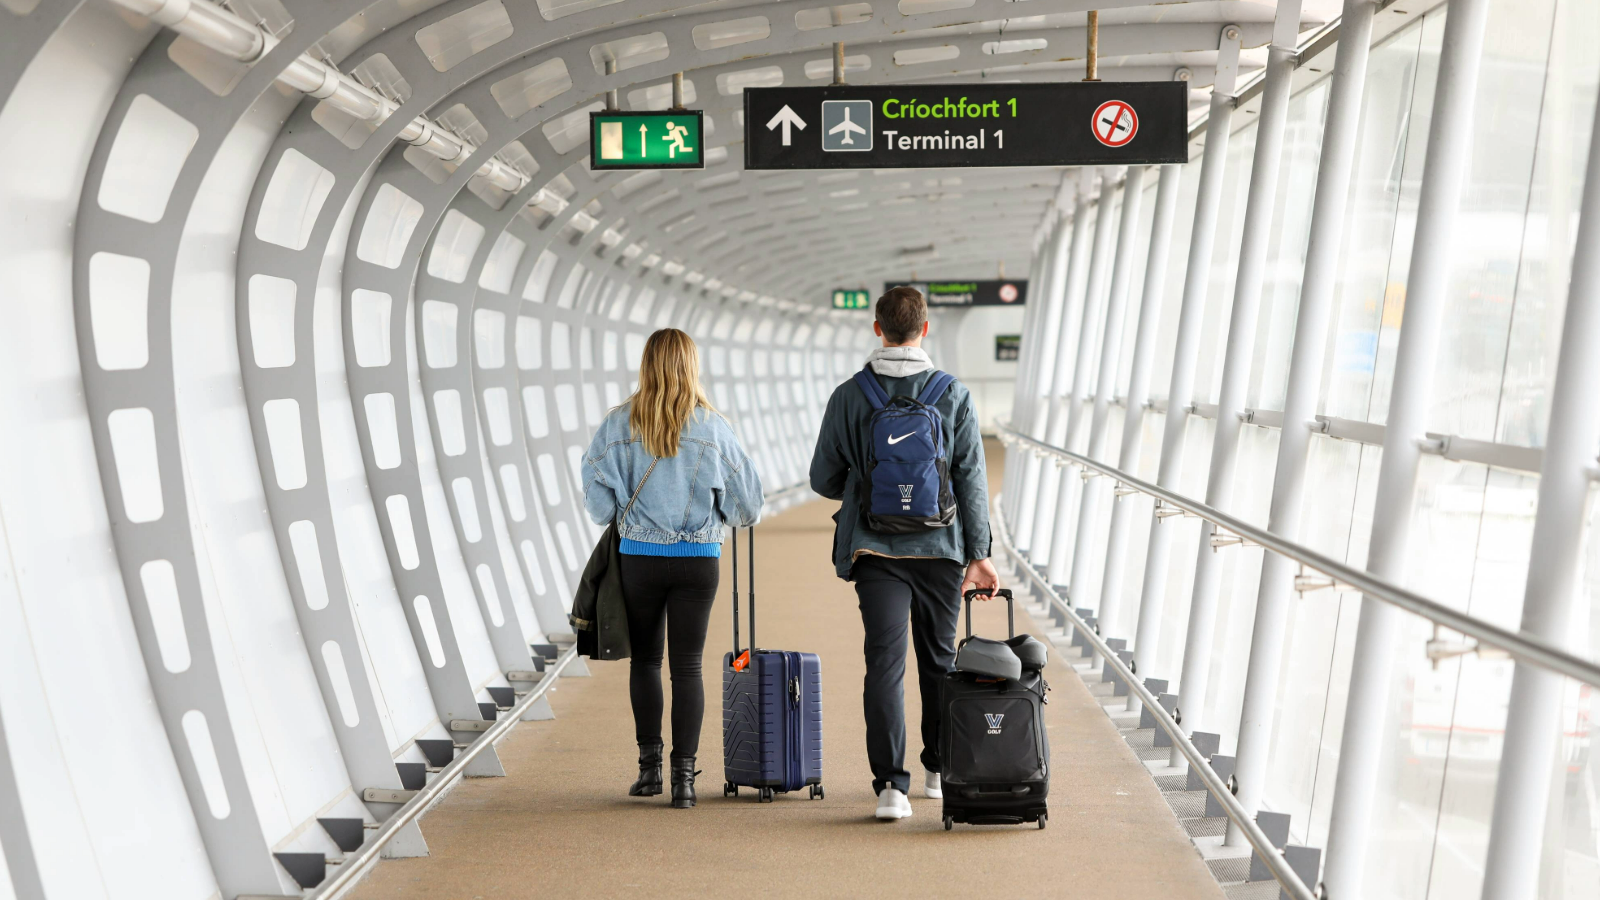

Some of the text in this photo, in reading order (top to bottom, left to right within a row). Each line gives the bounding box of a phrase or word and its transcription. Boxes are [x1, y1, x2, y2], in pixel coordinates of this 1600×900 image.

[882, 97, 1017, 119] Críochfort 1
[882, 128, 1003, 150] Terminal 1
